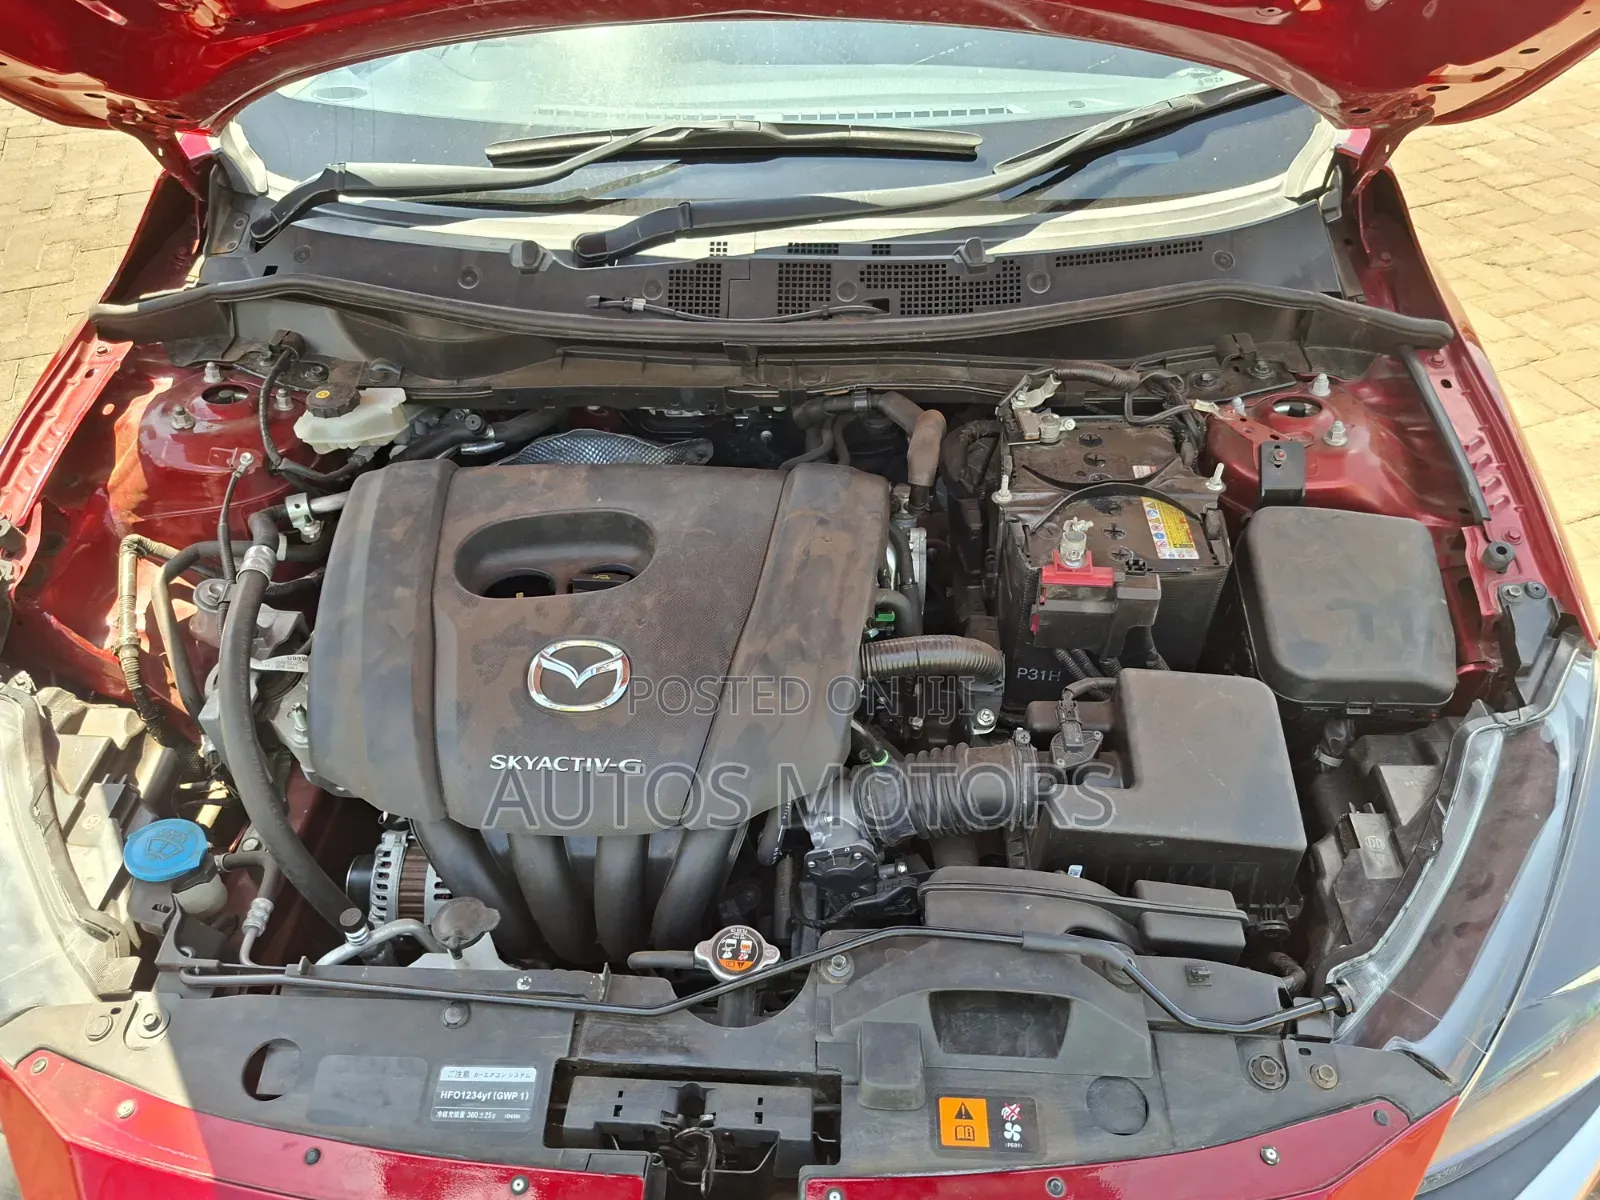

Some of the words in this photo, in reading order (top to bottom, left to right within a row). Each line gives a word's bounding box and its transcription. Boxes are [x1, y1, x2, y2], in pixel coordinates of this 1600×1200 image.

[1016, 666, 1062, 682] P31H
[489, 754, 643, 775] SKYACTIV-G
[447, 1070, 470, 1079] ご注意
[440, 1090, 492, 1102] HFO1234yf
[493, 1090, 518, 1101] (GWP
[520, 1091, 529, 1101] 1)
